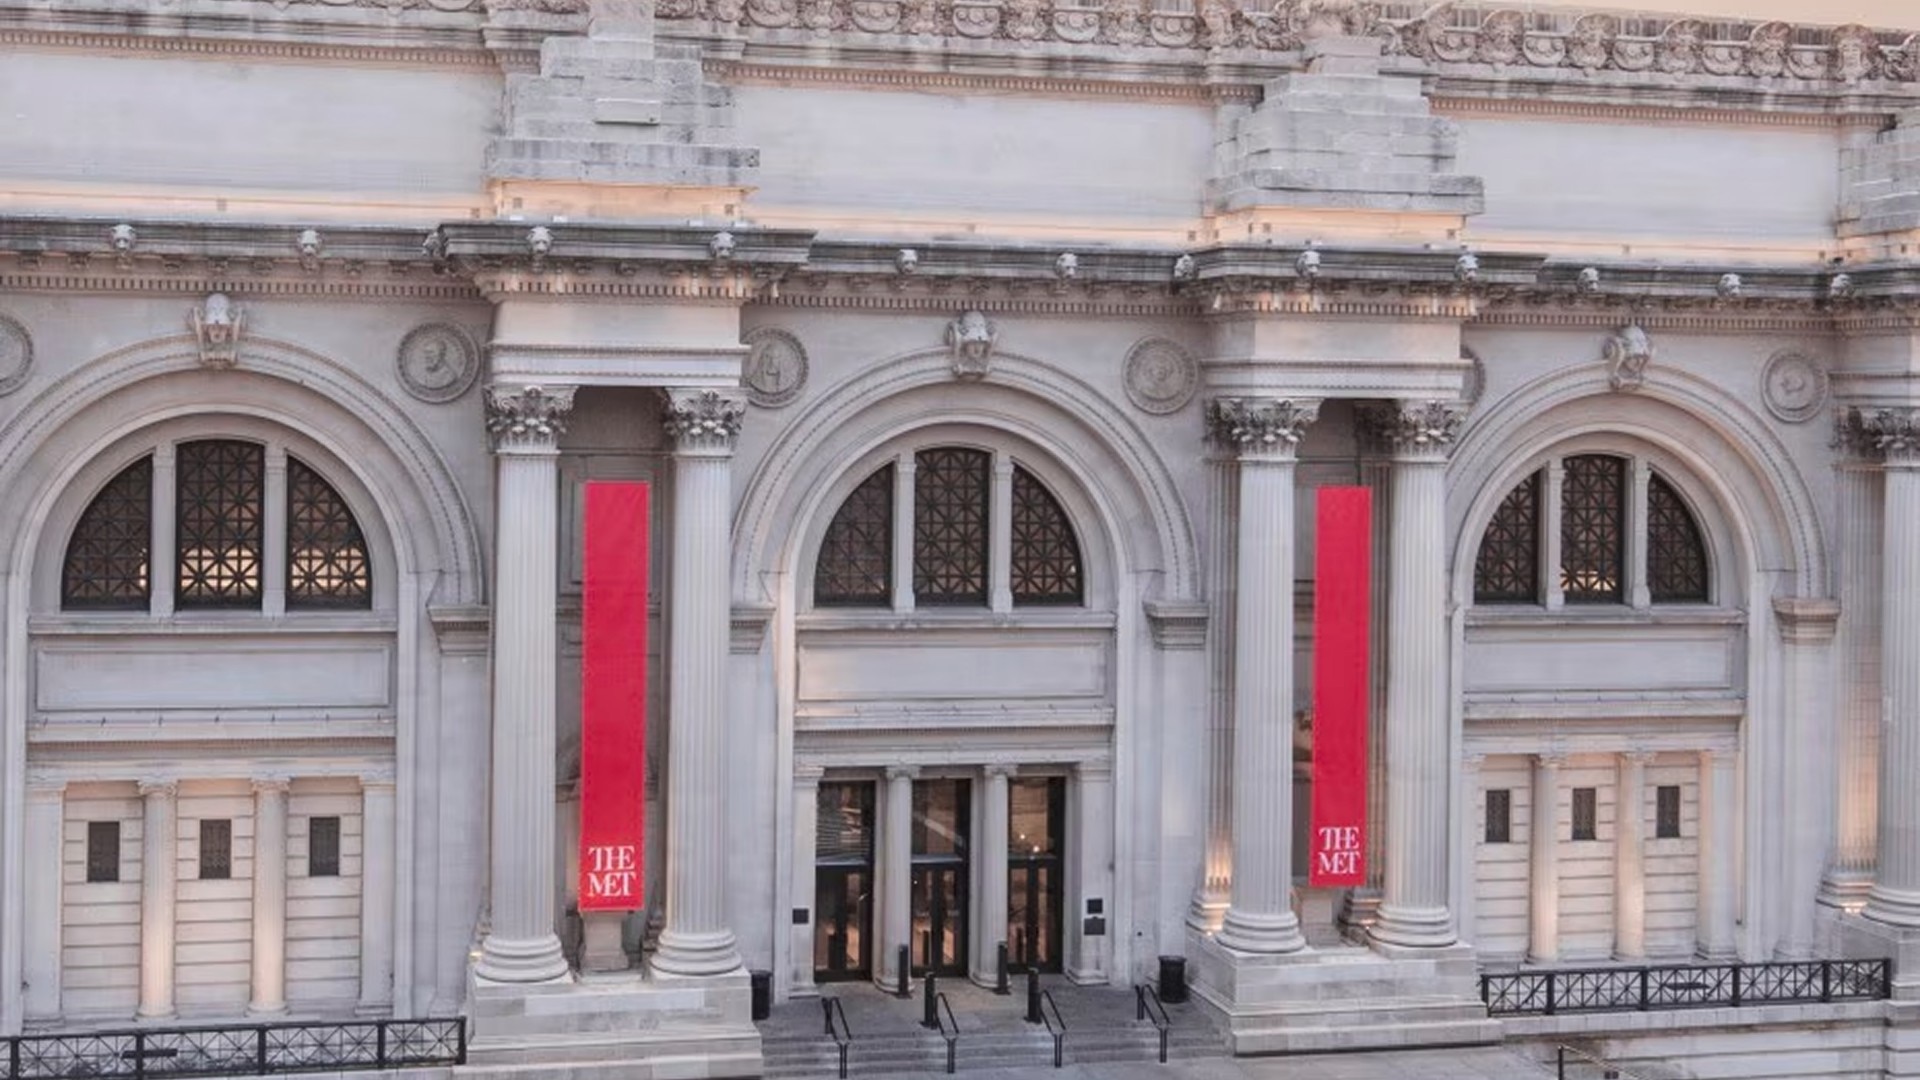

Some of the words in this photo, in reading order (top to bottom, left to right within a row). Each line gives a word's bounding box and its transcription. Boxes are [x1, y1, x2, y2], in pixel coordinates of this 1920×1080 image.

[1318, 827, 1360, 851] THE
[588, 845, 636, 872] THE
[1317, 851, 1361, 875] MET
[587, 871, 637, 897] MET
